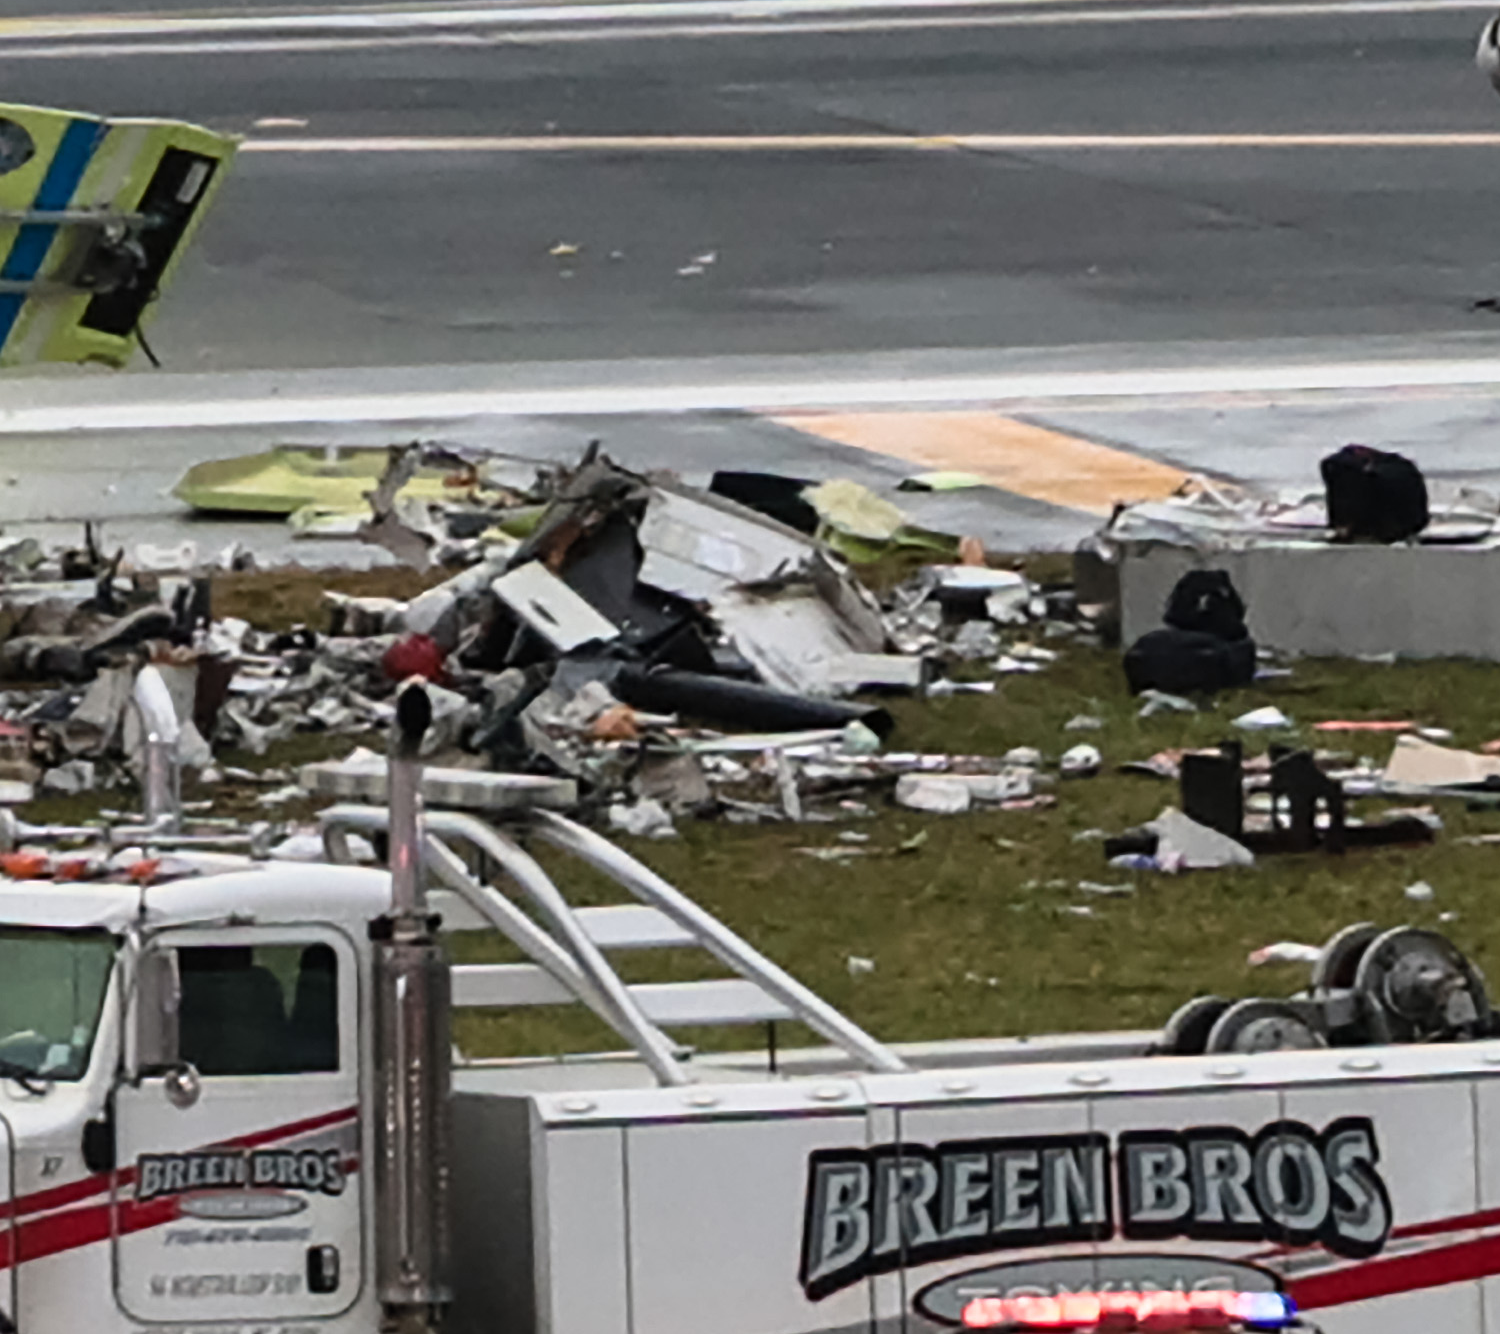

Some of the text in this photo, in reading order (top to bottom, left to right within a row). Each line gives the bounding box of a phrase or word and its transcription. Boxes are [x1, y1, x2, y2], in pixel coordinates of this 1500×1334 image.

[136, 1149, 347, 1201] BREEN BROS
[800, 1117, 1393, 1301] BREEN BROS
